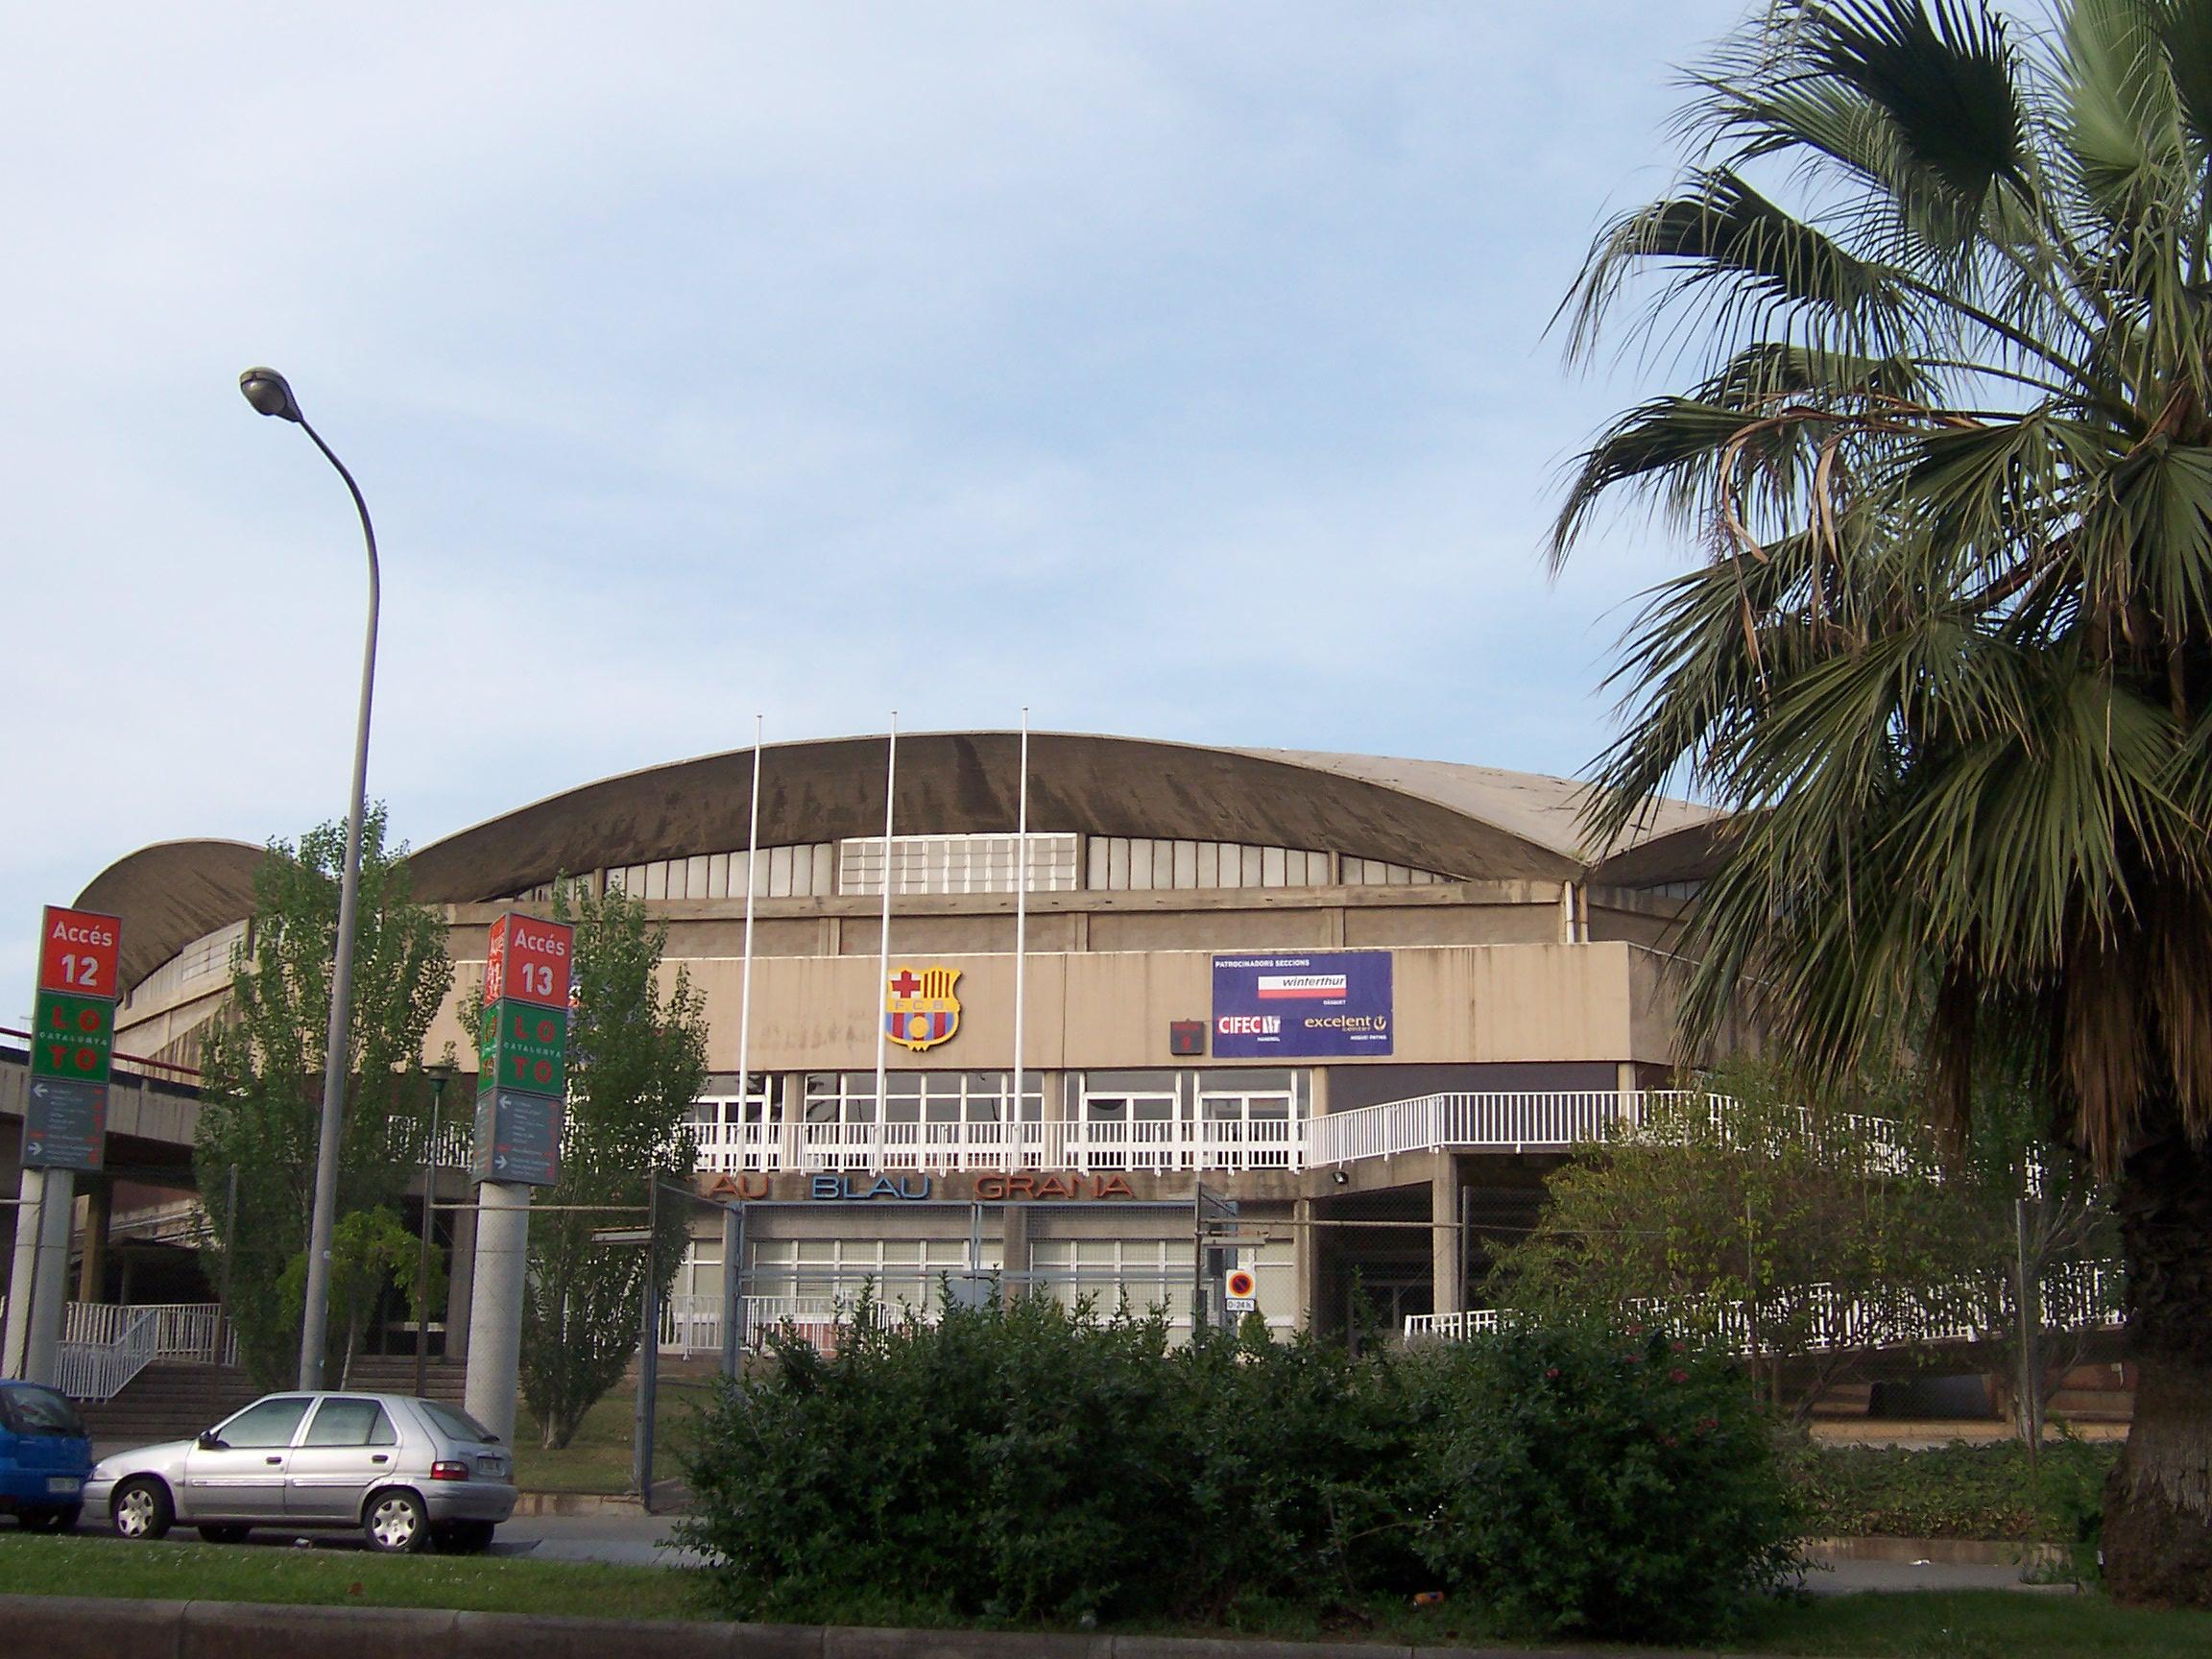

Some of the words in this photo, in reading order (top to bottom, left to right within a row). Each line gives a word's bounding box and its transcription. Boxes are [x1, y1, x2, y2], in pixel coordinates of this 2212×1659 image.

[52, 921, 113, 947] Accés
[514, 927, 565, 956] Accés
[61, 953, 99, 987] 12
[521, 962, 554, 996] 13
[1283, 976, 1345, 987] winterthur
[1218, 1016, 1262, 1034] CIFEC
[1304, 1015, 1371, 1028] excelent
[811, 1175, 930, 1199] BLAU
[974, 1174, 1137, 1199] GRANA
